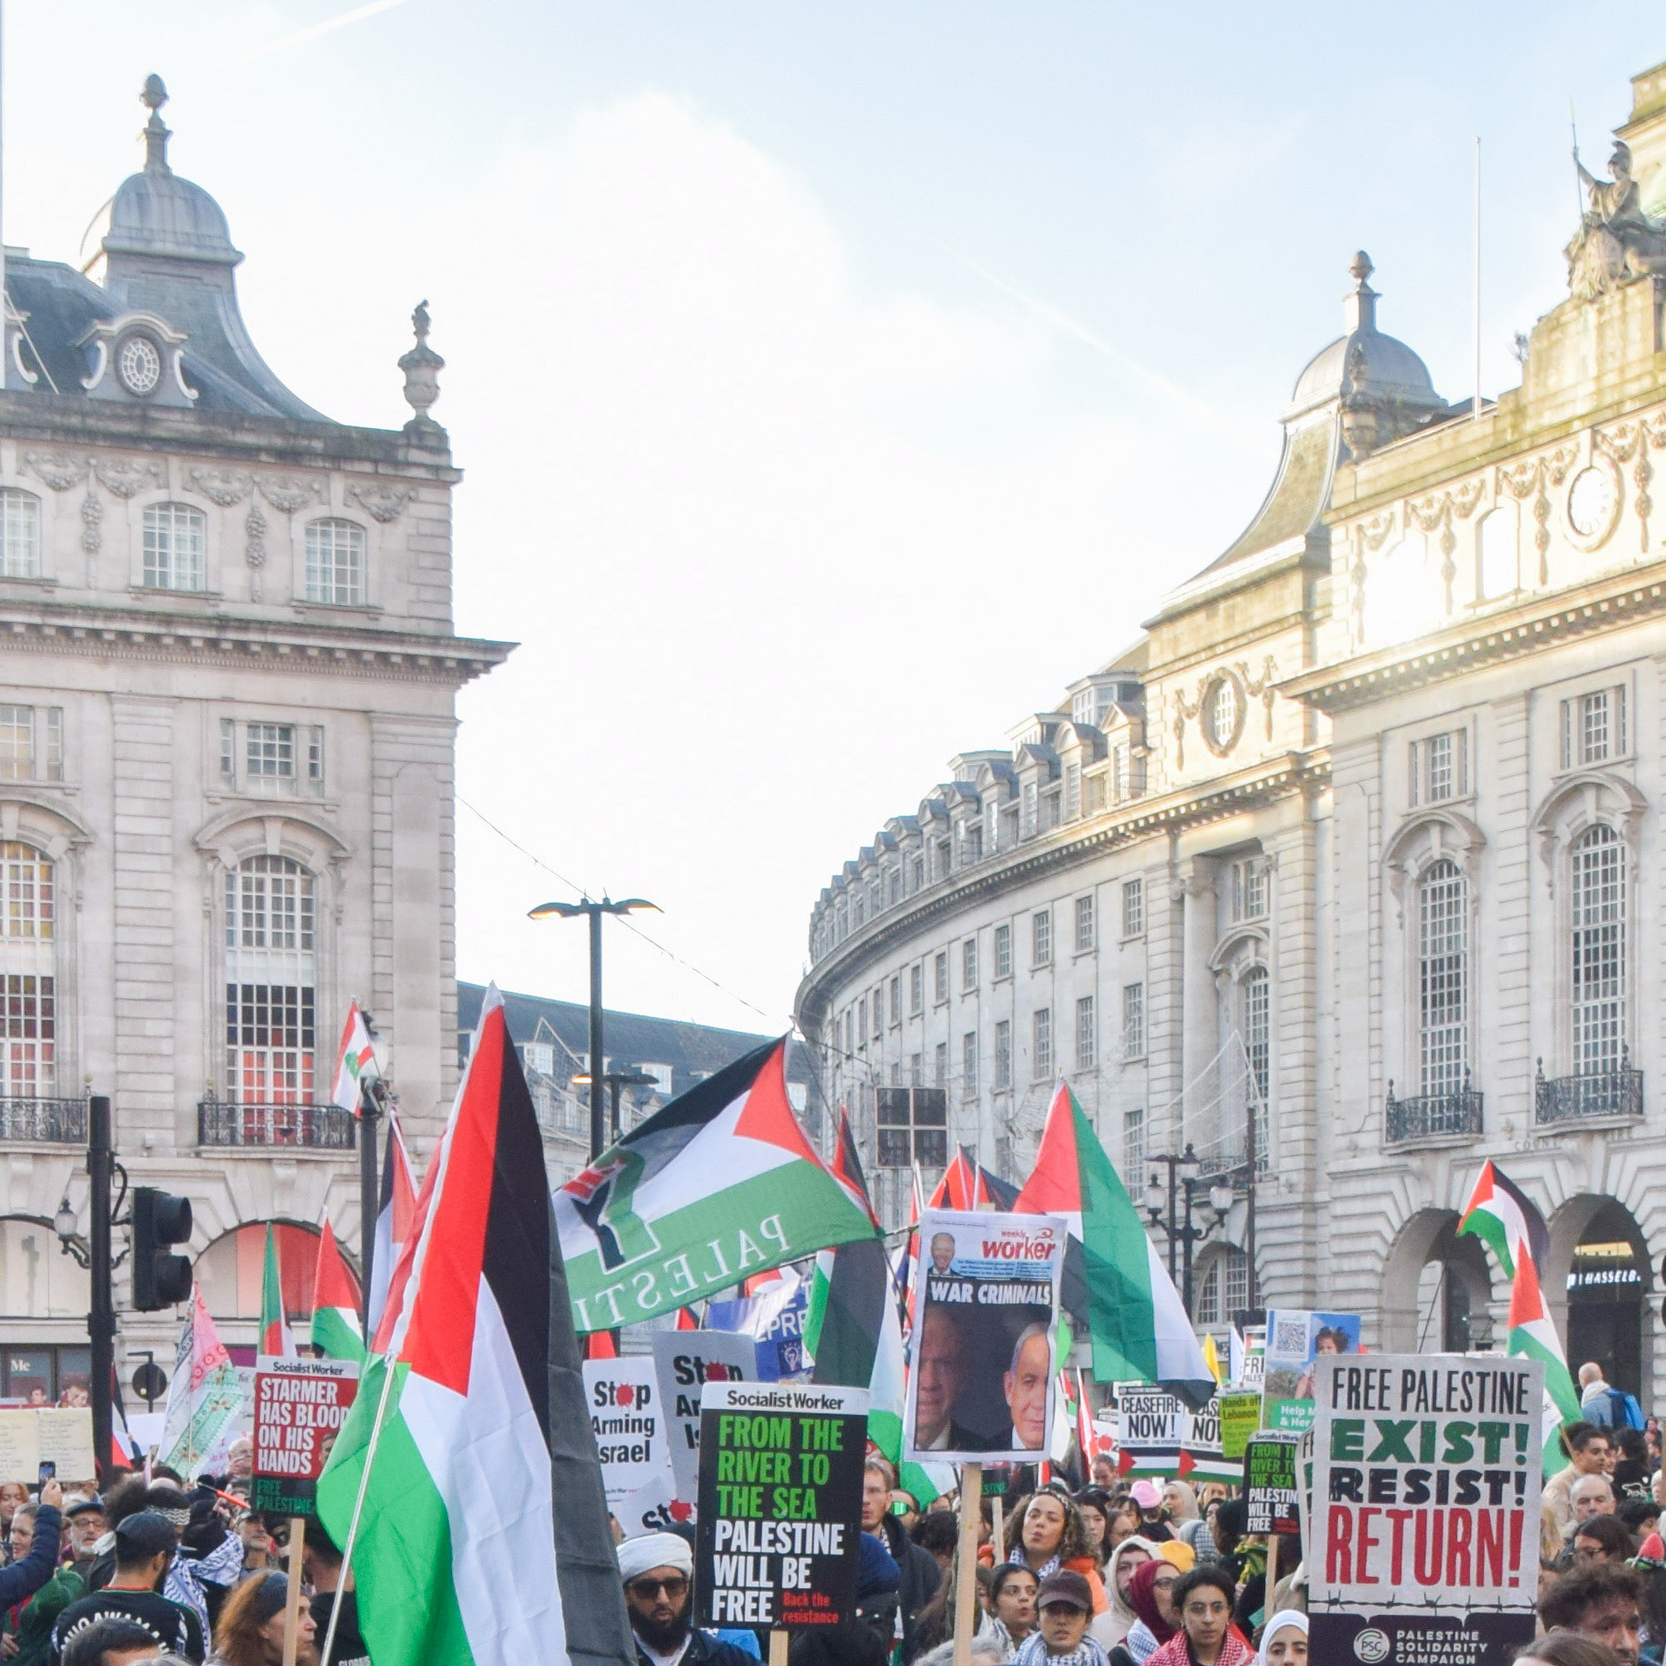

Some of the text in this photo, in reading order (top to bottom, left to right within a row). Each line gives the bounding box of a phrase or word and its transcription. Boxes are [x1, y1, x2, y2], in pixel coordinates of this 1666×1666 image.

[981, 1236, 1056, 1260] worker
[1585, 1269, 1642, 1285] HASSELB
[930, 1281, 1052, 1305] WAR CRIMINALS
[10, 1359, 32, 1372] Me
[273, 1361, 344, 1376] Socialist Worker
[260, 1377, 338, 1404] STARMER
[727, 1389, 845, 1410] Socialist Worker
[1332, 1367, 1530, 1415] FREE PALESTINE
[259, 1401, 291, 1426] HAS
[1121, 1396, 1181, 1414] CEASEFIRE
[1280, 1404, 1307, 1418] Help
[1222, 1409, 1258, 1421] Lebanon
[1279, 1416, 1311, 1428] & Her
[591, 1413, 655, 1438] Arming
[719, 1415, 792, 1449] FROM
[799, 1418, 845, 1451] THE
[258, 1426, 315, 1450] ON HIS
[1329, 1418, 1530, 1466] EXIST!
[598, 1439, 651, 1464] srael
[1251, 1443, 1281, 1459] FROM
[257, 1449, 312, 1475] HANDS
[717, 1450, 831, 1485] RIVER TO
[1250, 1458, 1280, 1474] RIVER
[256, 1479, 282, 1496] FREE
[1249, 1473, 1293, 1488] THE SEA
[1328, 1466, 1528, 1507] RESIST!
[716, 1485, 818, 1520] THE SEA
[1248, 1487, 1299, 1504] PALESTIN
[1247, 1502, 1290, 1518] WILL BE
[1247, 1517, 1271, 1533] FREE
[715, 1519, 845, 1556] PALESTINE
[1325, 1503, 1525, 1588] RETURN!
[713, 1554, 813, 1589] WILL BE
[711, 1589, 774, 1624] FREE
[783, 1592, 831, 1607] Back the
[783, 1609, 840, 1625] resistance
[1396, 1630, 1479, 1642] PALESTINE
[1360, 1639, 1383, 1653] PSC
[1396, 1642, 1489, 1653] SOLIDARITY
[1395, 1653, 1477, 1666] CAMPAIGN
